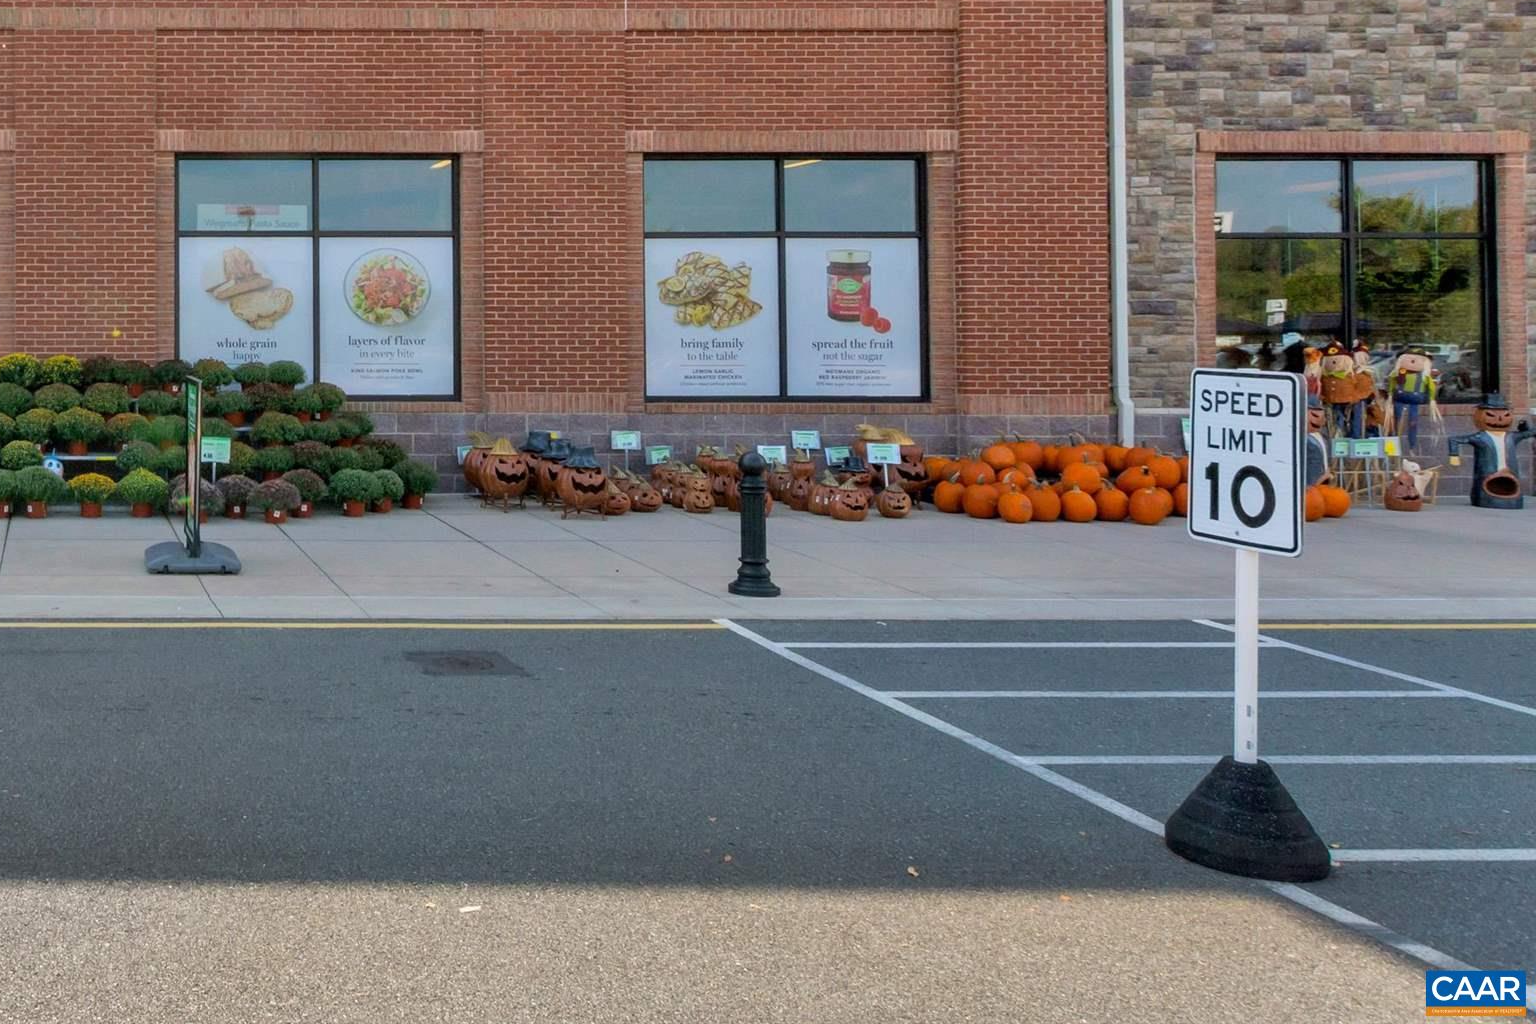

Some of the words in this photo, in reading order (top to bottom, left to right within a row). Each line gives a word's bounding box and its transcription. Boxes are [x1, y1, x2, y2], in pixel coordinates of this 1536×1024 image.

[216, 338, 247, 349] whole
[249, 338, 277, 351] grain
[348, 335, 379, 348] layers
[380, 335, 392, 346] of
[394, 335, 426, 346] flavor
[680, 338, 709, 350] bring
[711, 338, 744, 351] family
[811, 338, 847, 351] spread
[850, 338, 867, 349] the
[869, 338, 894, 349] fruit
[233, 350, 261, 361] happy
[359, 350, 368, 358] in
[370, 351, 395, 359] every
[397, 349, 415, 358] bite
[687, 352, 696, 360] to
[699, 351, 714, 360] the
[716, 351, 739, 360] table
[823, 352, 838, 360] not
[840, 351, 855, 360] the
[857, 353, 883, 362] sugar
[1200, 389, 1284, 418] SPEED
[1207, 426, 1273, 455] LIMIT
[1205, 462, 1276, 529] 10
